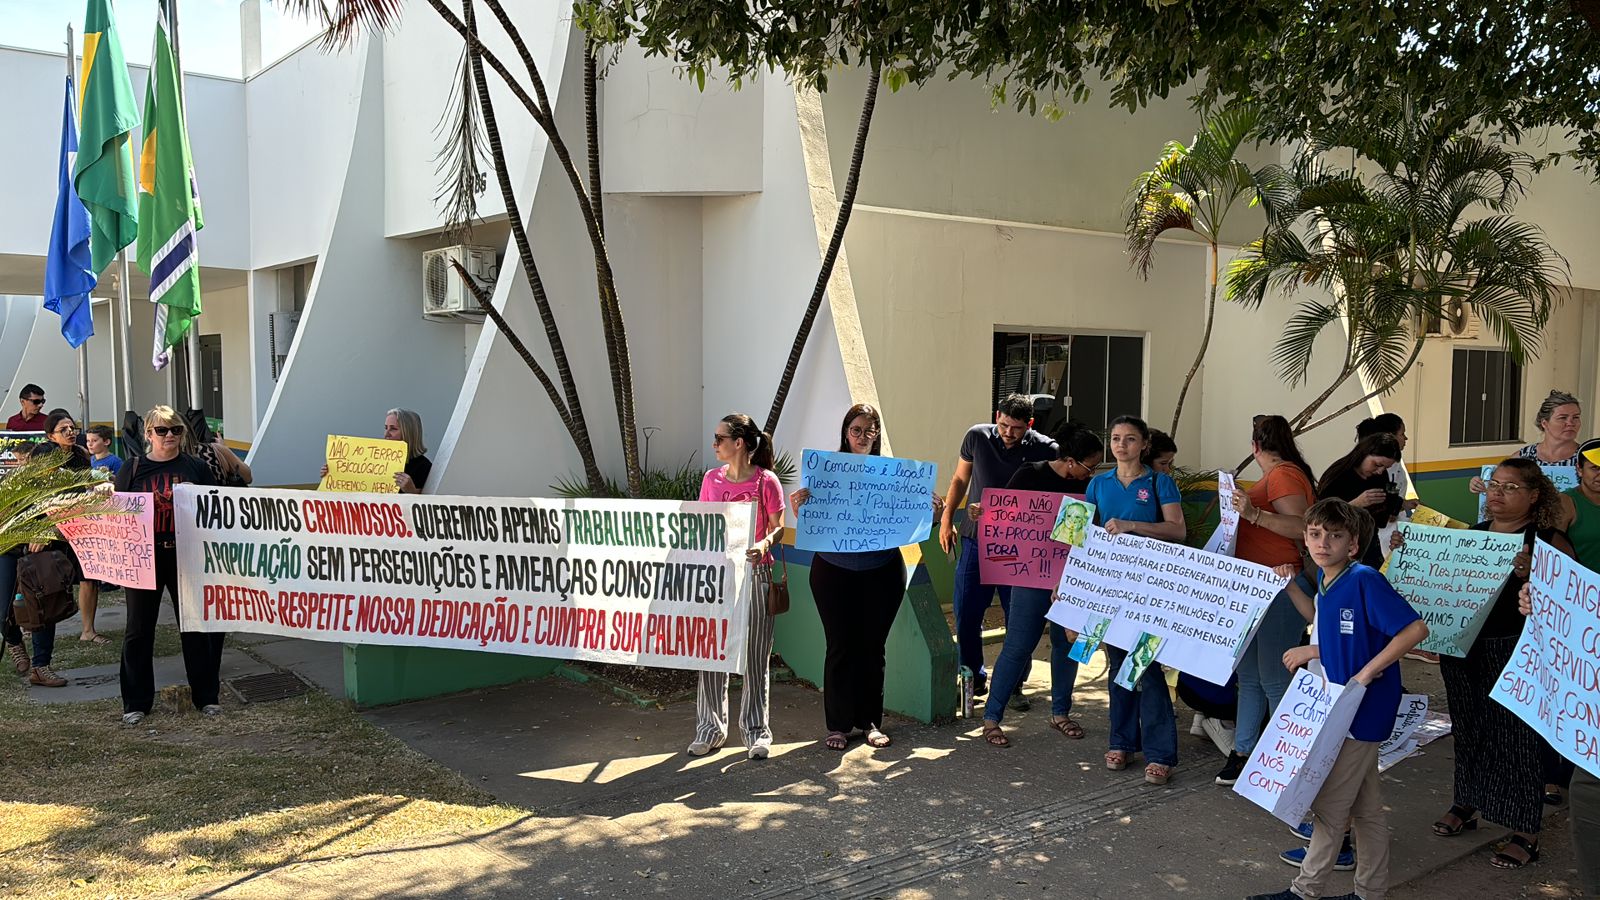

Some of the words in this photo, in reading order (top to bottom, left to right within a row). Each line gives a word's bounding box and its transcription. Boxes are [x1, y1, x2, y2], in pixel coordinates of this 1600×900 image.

[329, 437, 349, 457] NÃO
[352, 446, 364, 456] AO
[368, 446, 404, 463] TERROR
[336, 457, 389, 475] PSICOLÓGICO!
[807, 452, 819, 470] O
[879, 464, 889, 476] é
[326, 475, 367, 491] QUEREMOS
[805, 475, 841, 489] Nossa
[848, 478, 930, 499] permanência
[804, 491, 850, 506] também
[990, 495, 1018, 508] DIGA
[1029, 494, 1053, 511] NÃO
[195, 489, 235, 529] NÃO
[239, 495, 301, 532] SOMOS
[302, 500, 412, 538] CRIMINOSOS.
[412, 503, 498, 543] QUEREMOS
[502, 507, 561, 544] APENAS
[562, 508, 656, 548] TRABALHAR
[657, 512, 667, 548] E
[668, 513, 726, 552] SERVIR
[802, 508, 832, 523] pare
[837, 509, 854, 521] de
[858, 508, 913, 524] brincar
[991, 509, 1045, 525] JOGADAS
[805, 525, 837, 535] com
[844, 526, 900, 535] nossas
[123, 541, 153, 557] PROVE
[832, 535, 887, 551] VIDAS!
[986, 542, 1018, 556] FORA
[1032, 548, 1047, 558] DO
[1092, 530, 1113, 543] MEU
[1116, 536, 1144, 549] SALÁRIO
[1189, 552, 1195, 562] A
[1197, 553, 1215, 568] VIDA
[1217, 560, 1233, 572] DO
[1233, 564, 1254, 579] MEU
[1398, 543, 1431, 565] força
[1436, 548, 1451, 562] de
[1452, 553, 1489, 566] nossos
[203, 541, 215, 574] A
[214, 537, 300, 585] POPULAÇÃO
[307, 545, 345, 582] SEM
[350, 546, 476, 593] PERSEGUIÇÕES
[481, 554, 492, 589] E
[496, 555, 597, 601] AMEAÇAS
[602, 559, 725, 604] CONSTANTES!
[1003, 561, 1033, 576] JÁ
[1088, 548, 1107, 560] UMA
[1110, 552, 1138, 567] DOENÇA
[1137, 557, 1159, 570] RARA
[1159, 562, 1166, 572] E
[1231, 581, 1249, 594] UM
[1251, 587, 1273, 601] DOS
[1069, 556, 1123, 580] TRATAMENTOS
[1125, 571, 1143, 582] MAIS
[1147, 575, 1175, 591] CAROS
[1177, 583, 1189, 595] DO
[1190, 589, 1226, 608] MUNDO,
[1229, 601, 1249, 614] ELE
[1066, 575, 1097, 592] TOMOU
[1096, 585, 1101, 594] A
[1149, 597, 1164, 608] DE
[1176, 604, 1216, 623] MILHÕES
[1217, 616, 1226, 626] E
[1225, 619, 1234, 629] O
[203, 585, 277, 624] PREFEITO:
[278, 591, 355, 631] RESPEITE
[355, 595, 414, 635] NOSSA
[418, 596, 519, 647] DEDICAÇÃO
[523, 605, 532, 644] E
[535, 606, 606, 650] CUMPRA
[610, 610, 643, 654] SUA
[646, 613, 728, 661] PALAVRA!
[1059, 592, 1086, 608] GASTO
[1087, 601, 1106, 613] DELE
[1125, 610, 1134, 619] 10
[1134, 612, 1141, 621] A
[1142, 614, 1151, 624] 15
[1152, 616, 1169, 629] MIL
[1170, 622, 1193, 637] REAIS
[1193, 628, 1236, 648] MENSAIS
[1500, 671, 1535, 705] SADO
[1556, 709, 1565, 742] É
